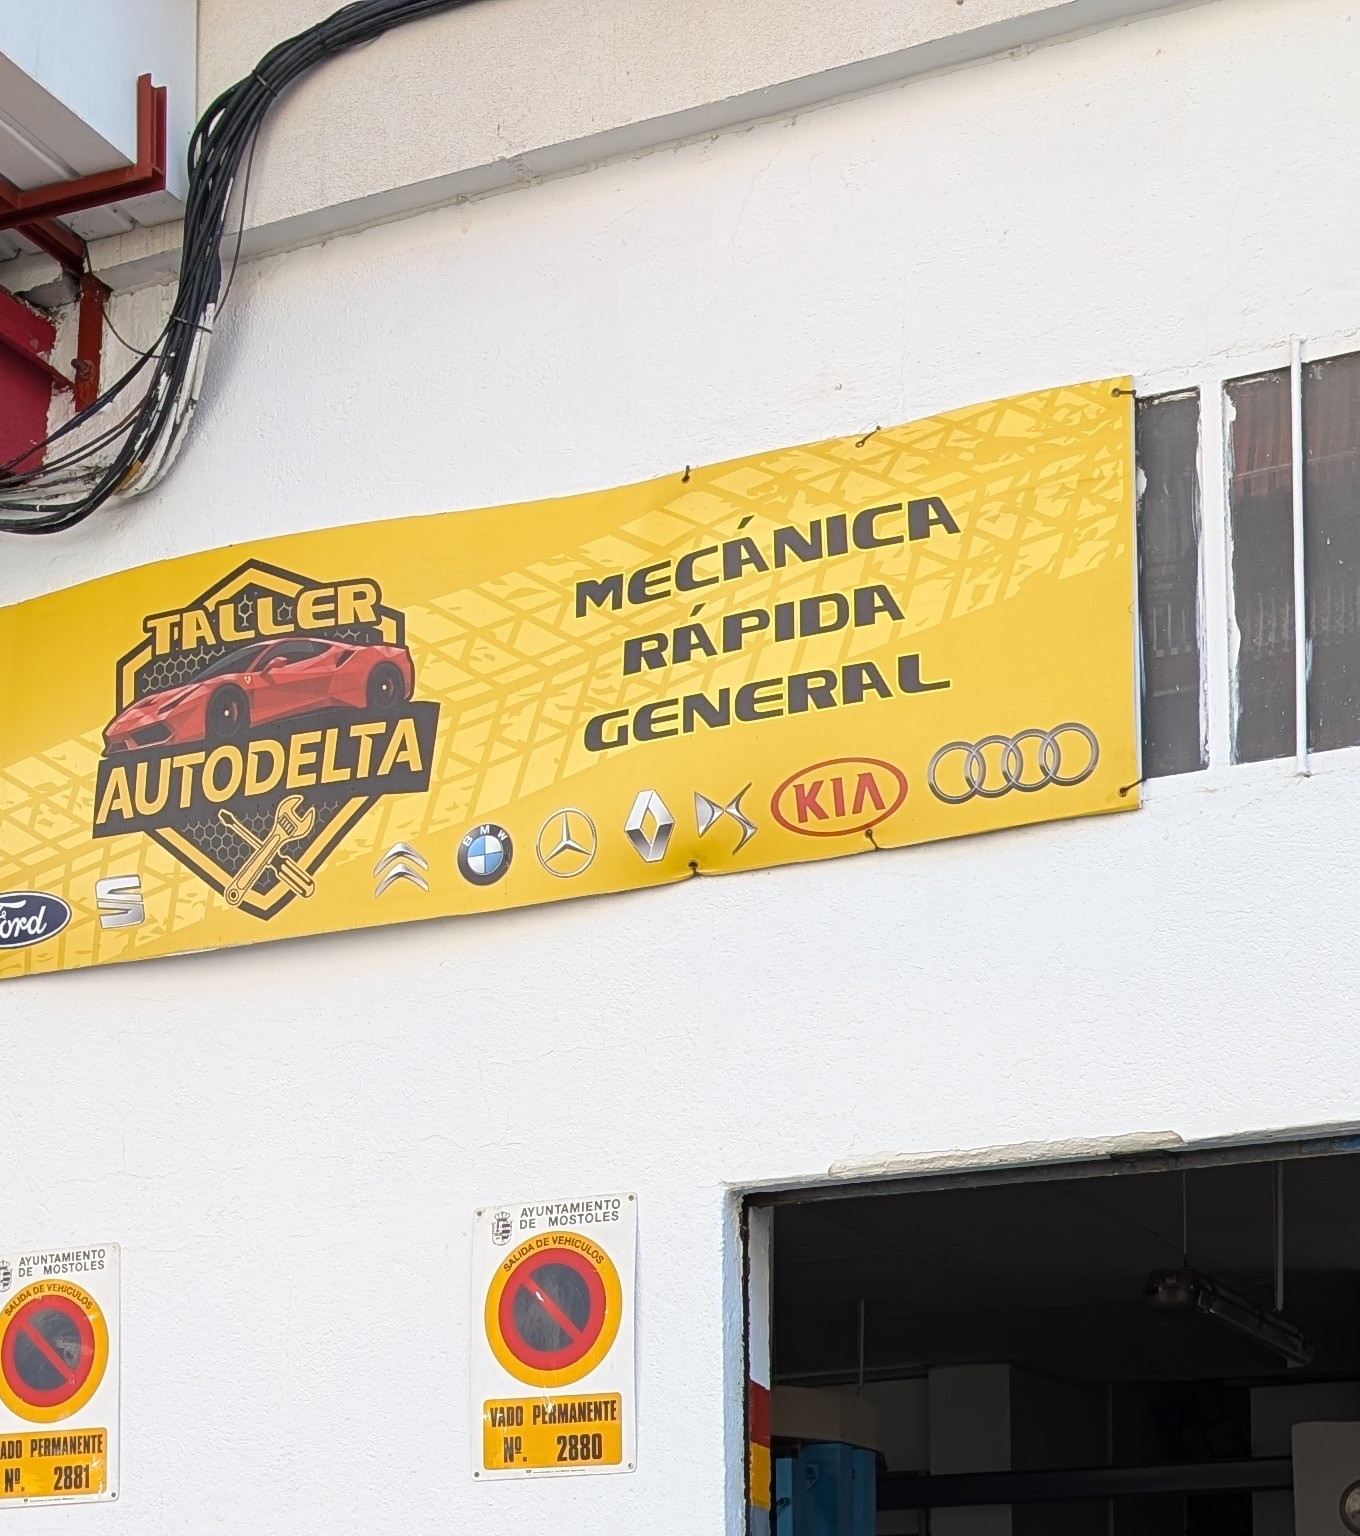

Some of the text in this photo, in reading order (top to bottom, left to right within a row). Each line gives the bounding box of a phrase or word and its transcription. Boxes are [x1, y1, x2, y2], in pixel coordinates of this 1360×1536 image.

[575, 496, 961, 618] MECÁNICA
[146, 582, 378, 656] TALLER
[623, 584, 905, 676] RÁPIDA
[583, 653, 951, 753] GENERAL
[95, 717, 424, 826] AUTODELTA
[796, 772, 888, 821] KIA
[461, 823, 509, 847] BMW
[519, 1210, 620, 1230] DE MOSTOLES
[520, 1199, 621, 1218] AYUNTAMIENTO
[18, 1248, 106, 1267] AYUNTAMIENTO
[18, 1259, 105, 1278] DE MOSTOLES
[503, 1235, 605, 1273] SALIDA DE VEHICULOS
[4, 1282, 93, 1317] SALIDA DE VEHICULOS
[489, 1399, 618, 1428] VADO PERMANENTE
[30, 1433, 103, 1458] PERMANENTE
[556, 1432, 603, 1462] 2880
[53, 1464, 91, 1491] 2881
